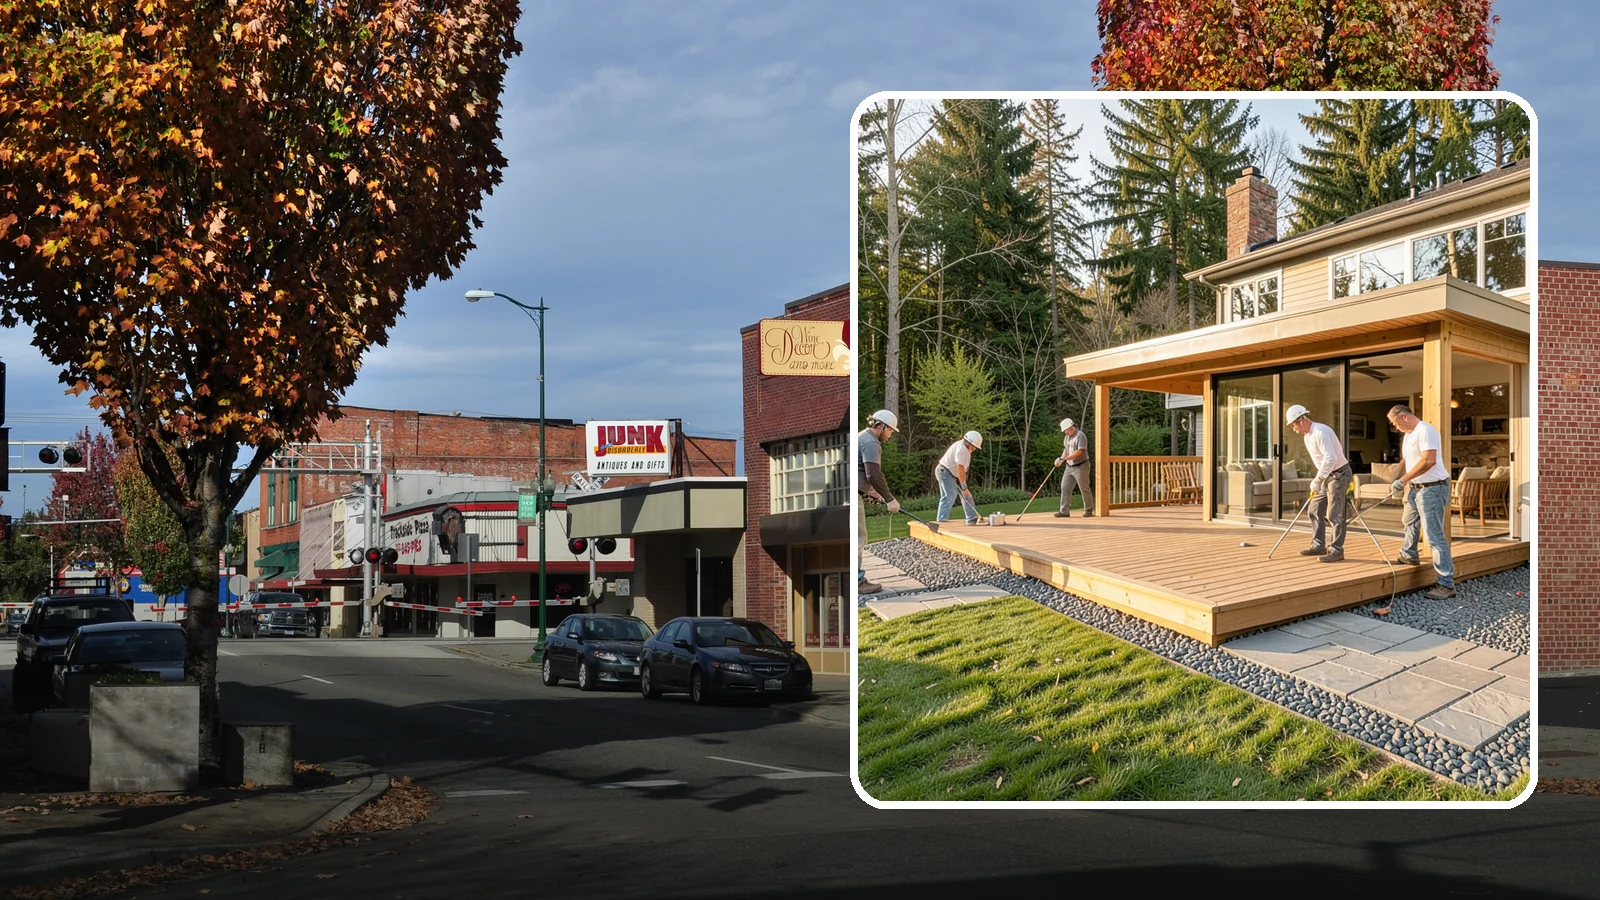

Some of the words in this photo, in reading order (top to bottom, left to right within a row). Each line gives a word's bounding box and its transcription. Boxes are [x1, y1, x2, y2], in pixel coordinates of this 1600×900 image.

[595, 425, 665, 457] JUNK
[607, 446, 646, 454] DISORDERLY
[596, 461, 628, 470] ANTIQUES
[631, 461, 644, 470] AND
[646, 460, 666, 469] GIFTS
[414, 519, 429, 535] Pizza
